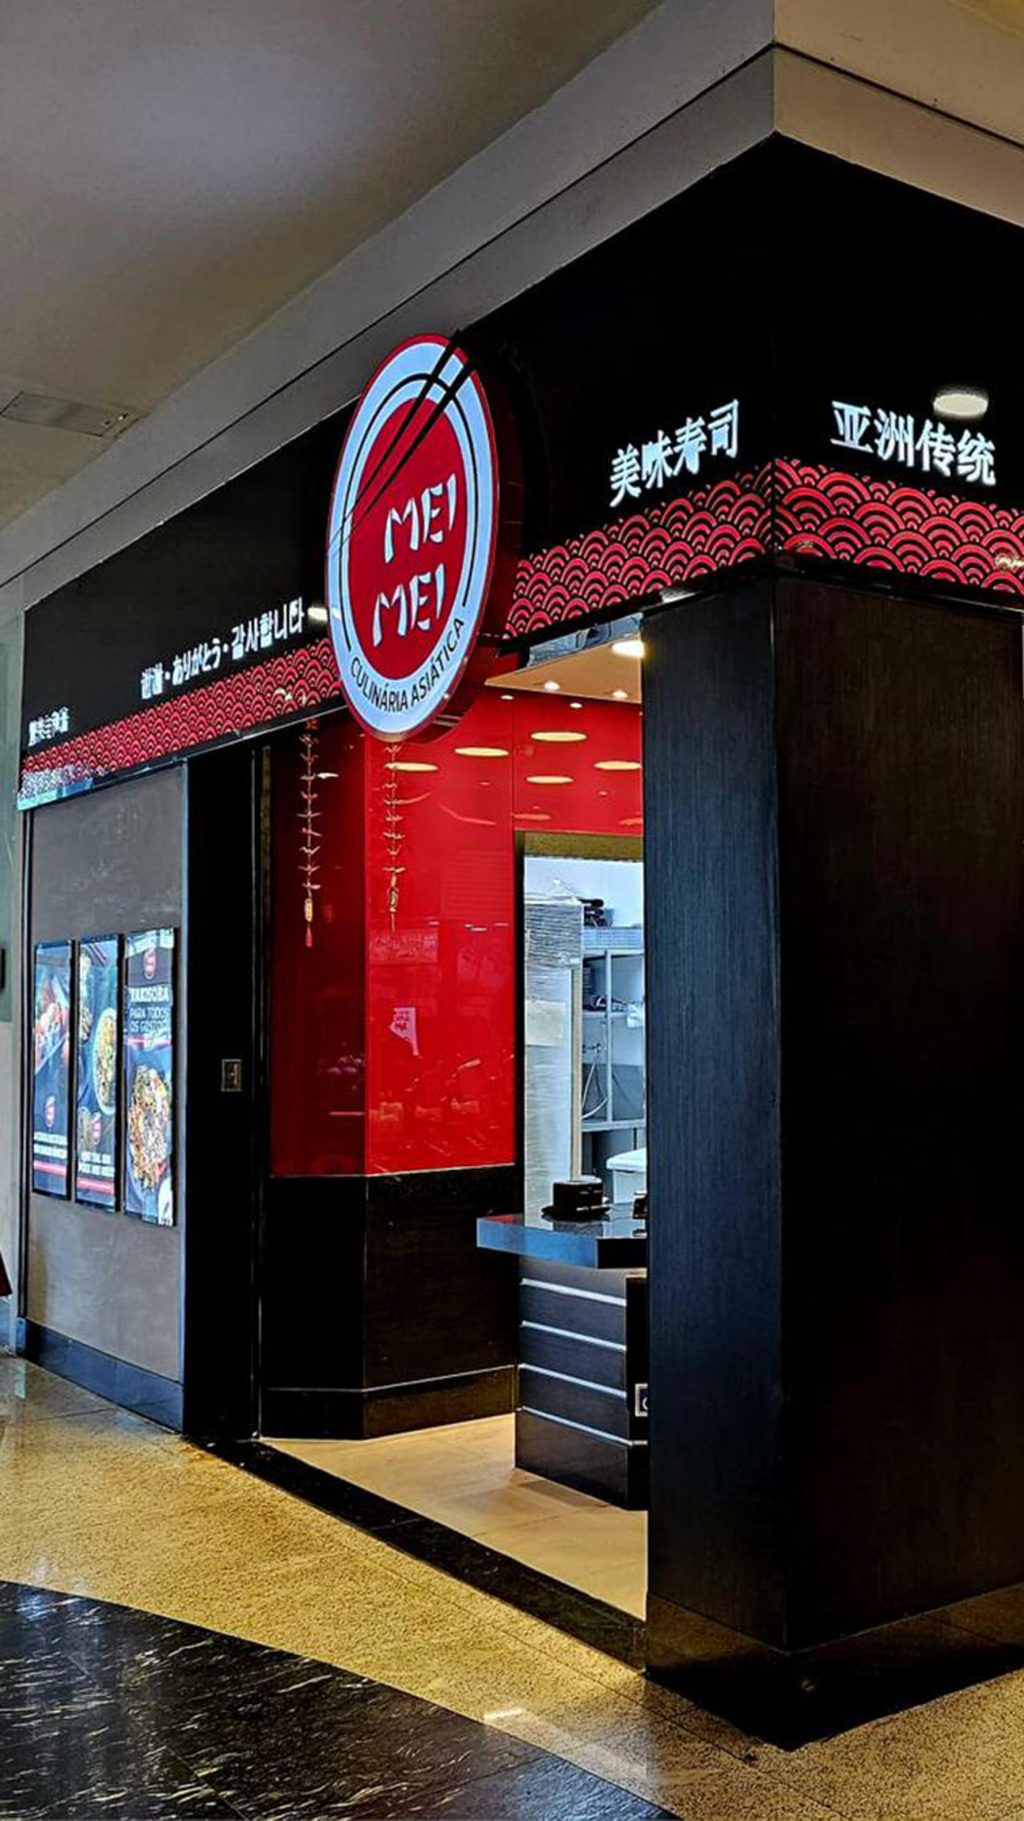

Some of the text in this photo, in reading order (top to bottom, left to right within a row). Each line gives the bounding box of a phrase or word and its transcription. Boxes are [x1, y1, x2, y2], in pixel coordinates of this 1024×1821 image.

[610, 399, 738, 508] 美味寿司
[830, 400, 996, 486] 亚洲传统
[384, 473, 457, 564] MEI
[373, 563, 446, 648] MEI
[350, 617, 465, 713] CULINÁRIA ASIÁTICA
